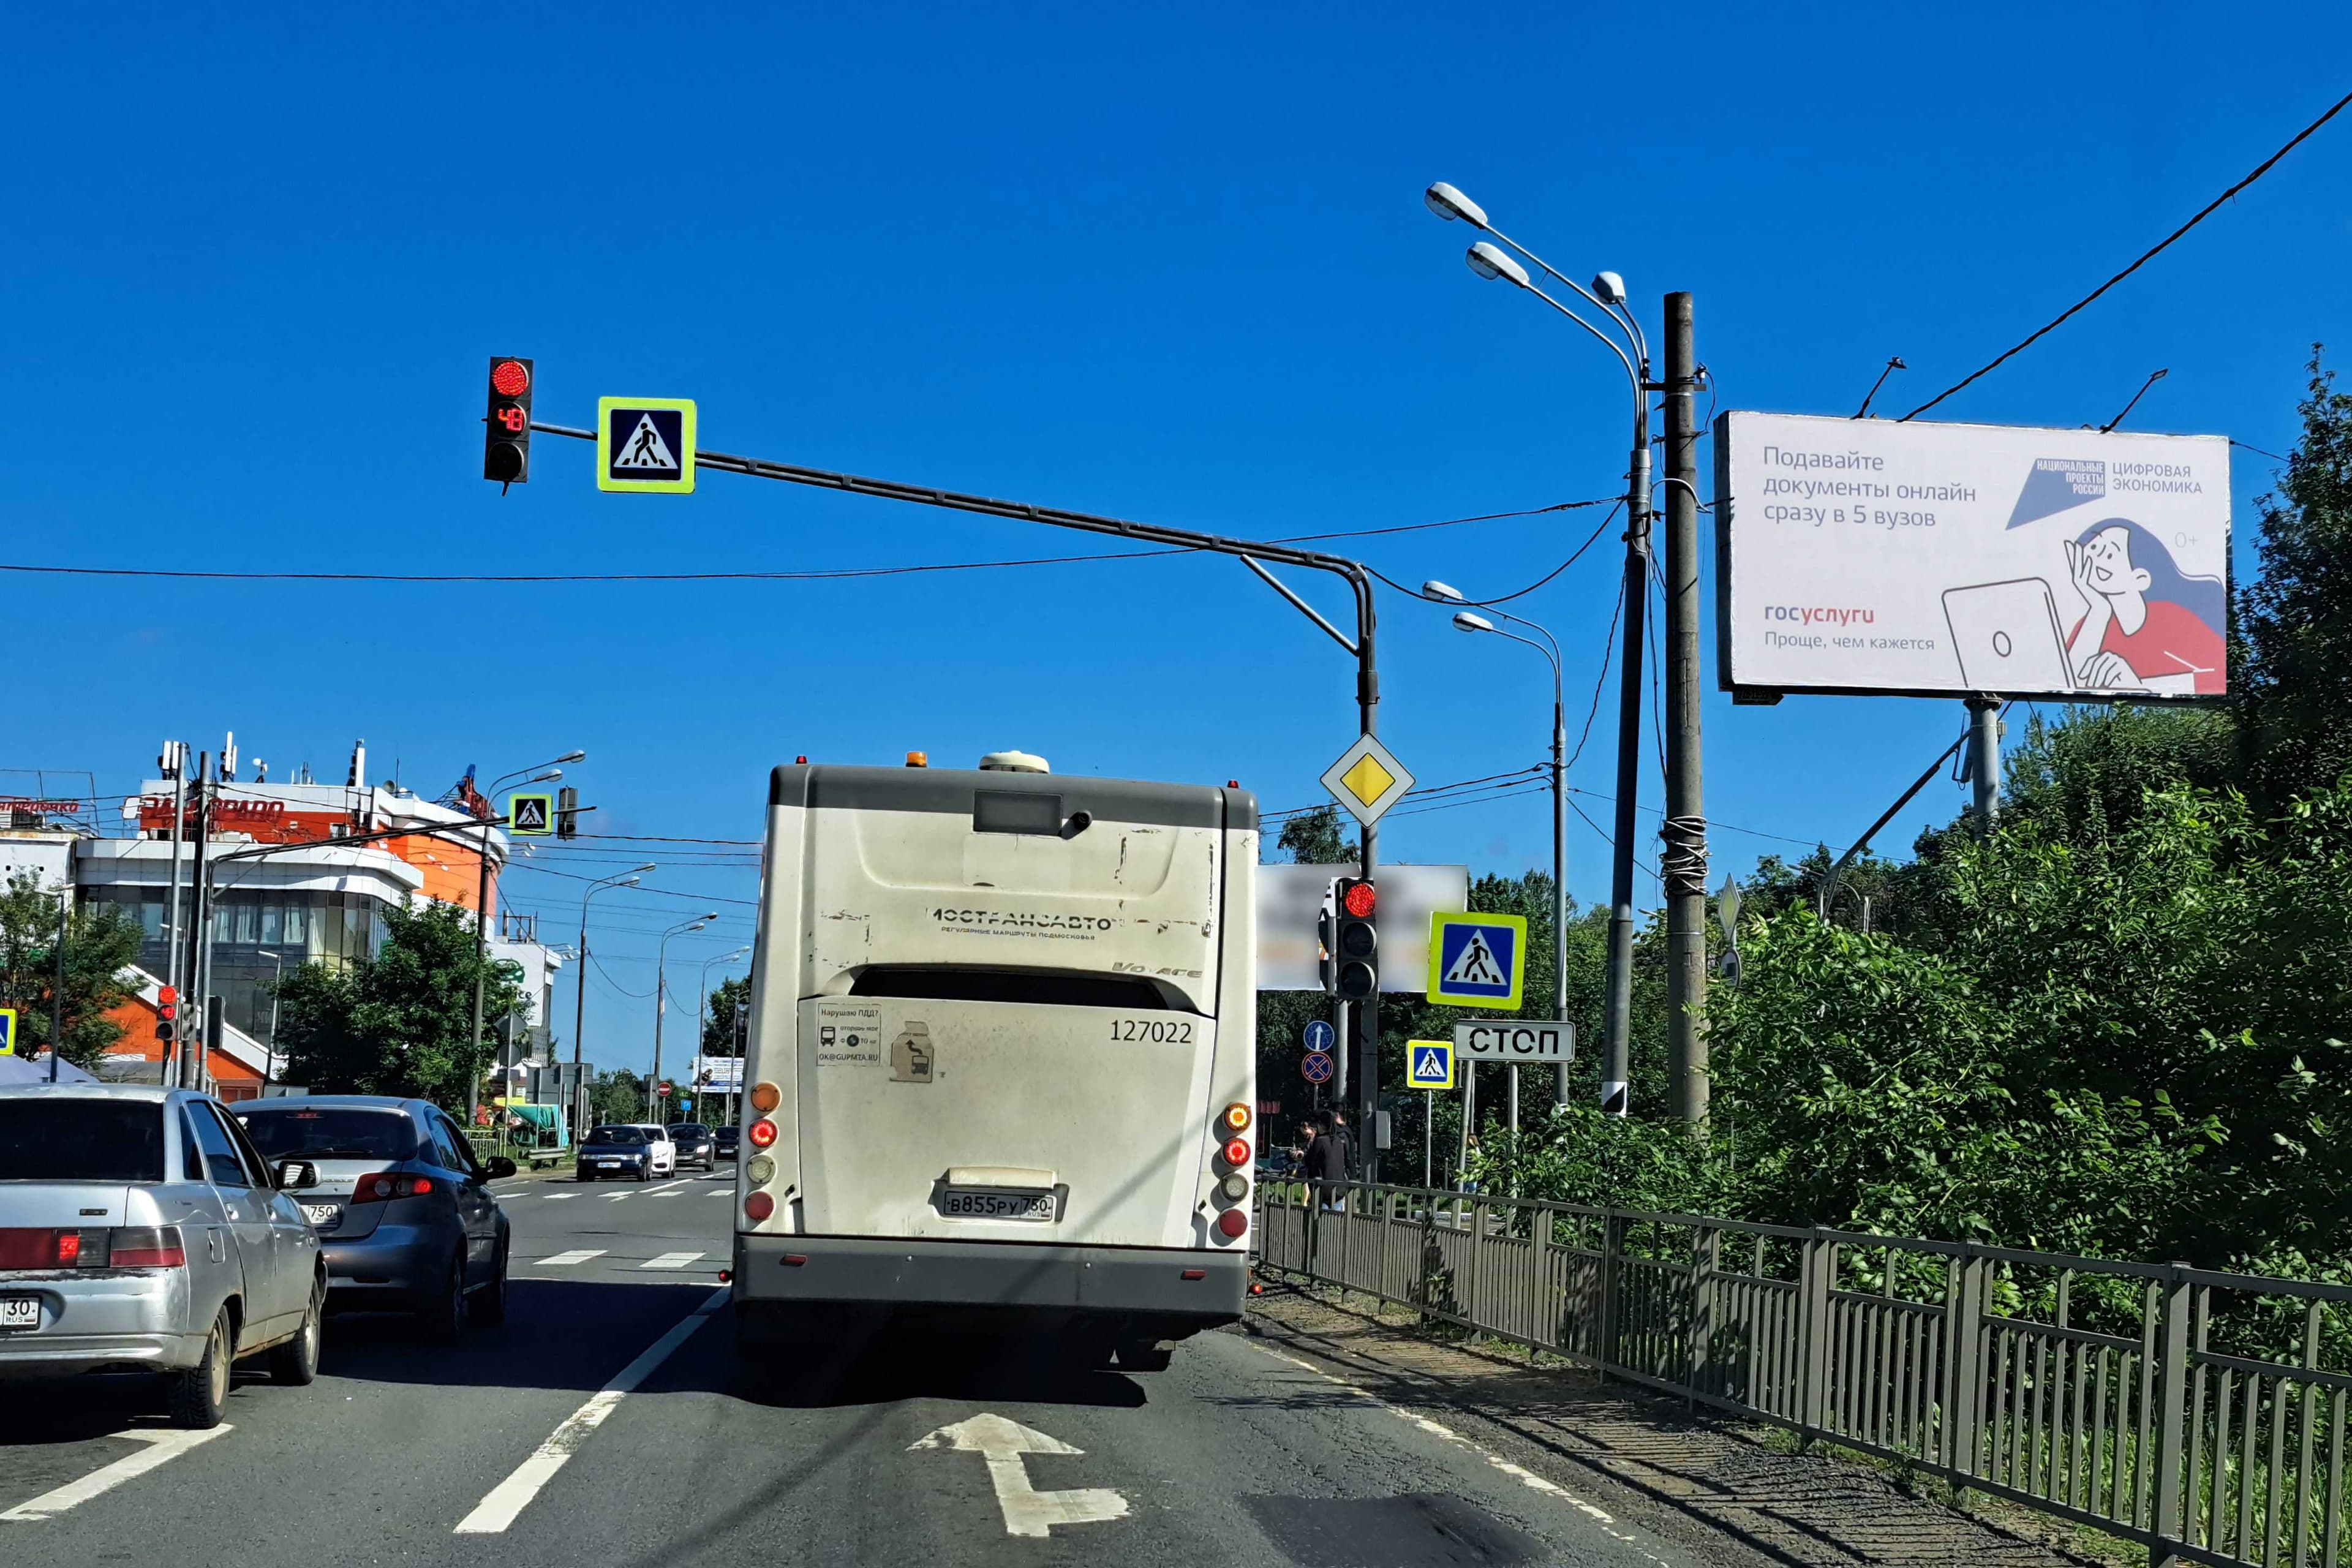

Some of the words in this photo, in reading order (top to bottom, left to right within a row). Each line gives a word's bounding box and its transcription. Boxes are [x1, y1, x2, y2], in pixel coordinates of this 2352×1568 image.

[1763, 446, 1884, 470] Подавайте
[2037, 461, 2104, 473] НАЦИОНАЛЬНЫЕ
[2113, 462, 2191, 477] ЦИФРОВАЯ
[2066, 473, 2104, 483] ПРОЕКТЫ
[2113, 478, 2203, 494] ЭКОНОМИКА
[1763, 478, 1890, 499] документы
[1897, 483, 1976, 501] онлайн
[2073, 483, 2104, 495] РОССИИ
[1764, 505, 1826, 527] сразу
[1833, 508, 1845, 522] в
[1853, 505, 1866, 523] 5
[1874, 511, 1936, 530] вузов
[2175, 532, 2198, 548] 0+
[1765, 606, 1874, 627] госуслуги
[1765, 631, 1827, 649] Проще,
[1833, 637, 1864, 648] чем
[1870, 638, 1935, 650] кажется
[821, 1009, 856, 1017] Нарушаю
[1110, 1019, 1191, 1044] 127022
[1469, 1027, 1559, 1054] СТОП
[311, 1206, 333, 1218] 750
[1023, 1197, 1047, 1212] 750
[7, 1300, 30, 1316] 30
